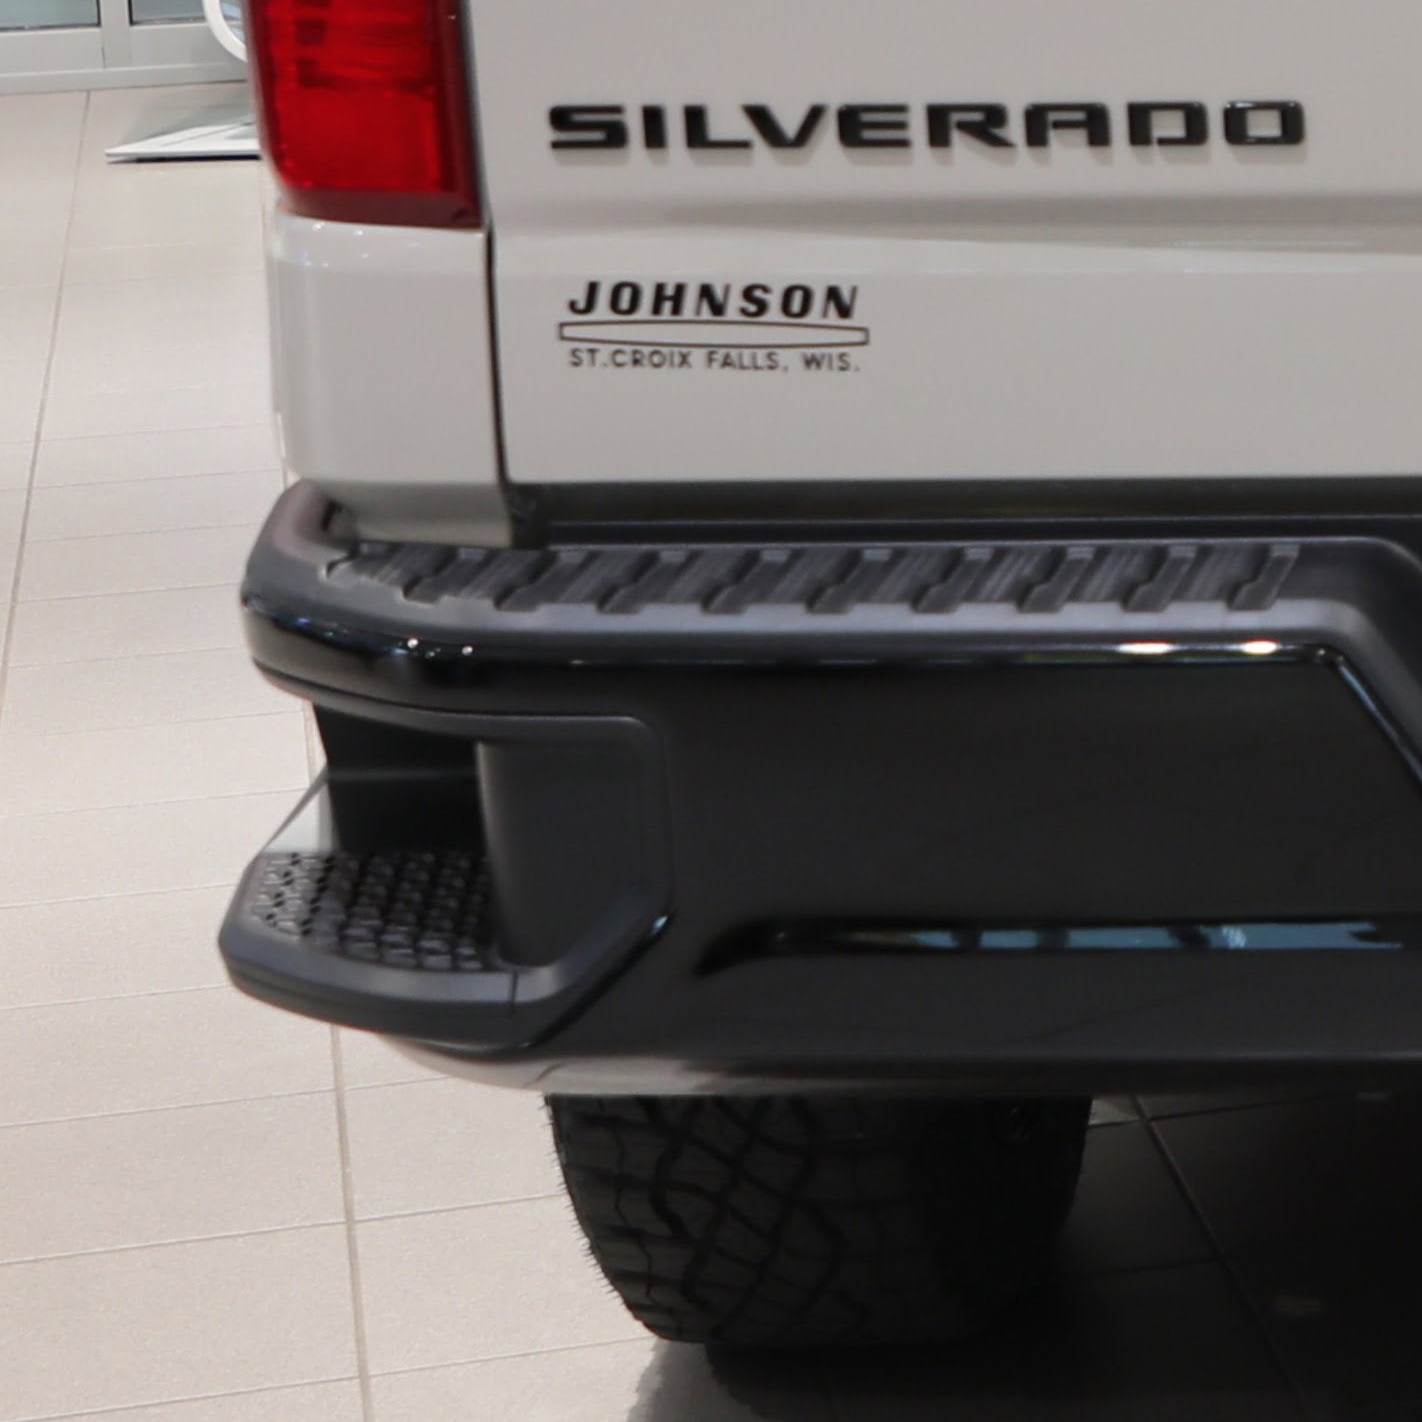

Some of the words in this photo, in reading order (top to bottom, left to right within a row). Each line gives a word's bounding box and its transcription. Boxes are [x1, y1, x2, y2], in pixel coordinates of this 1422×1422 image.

[548, 102, 1307, 150] SILVERADO
[568, 281, 858, 319] JOHNSON
[706, 349, 790, 373] FALLS,
[802, 352, 861, 372] WIS.
